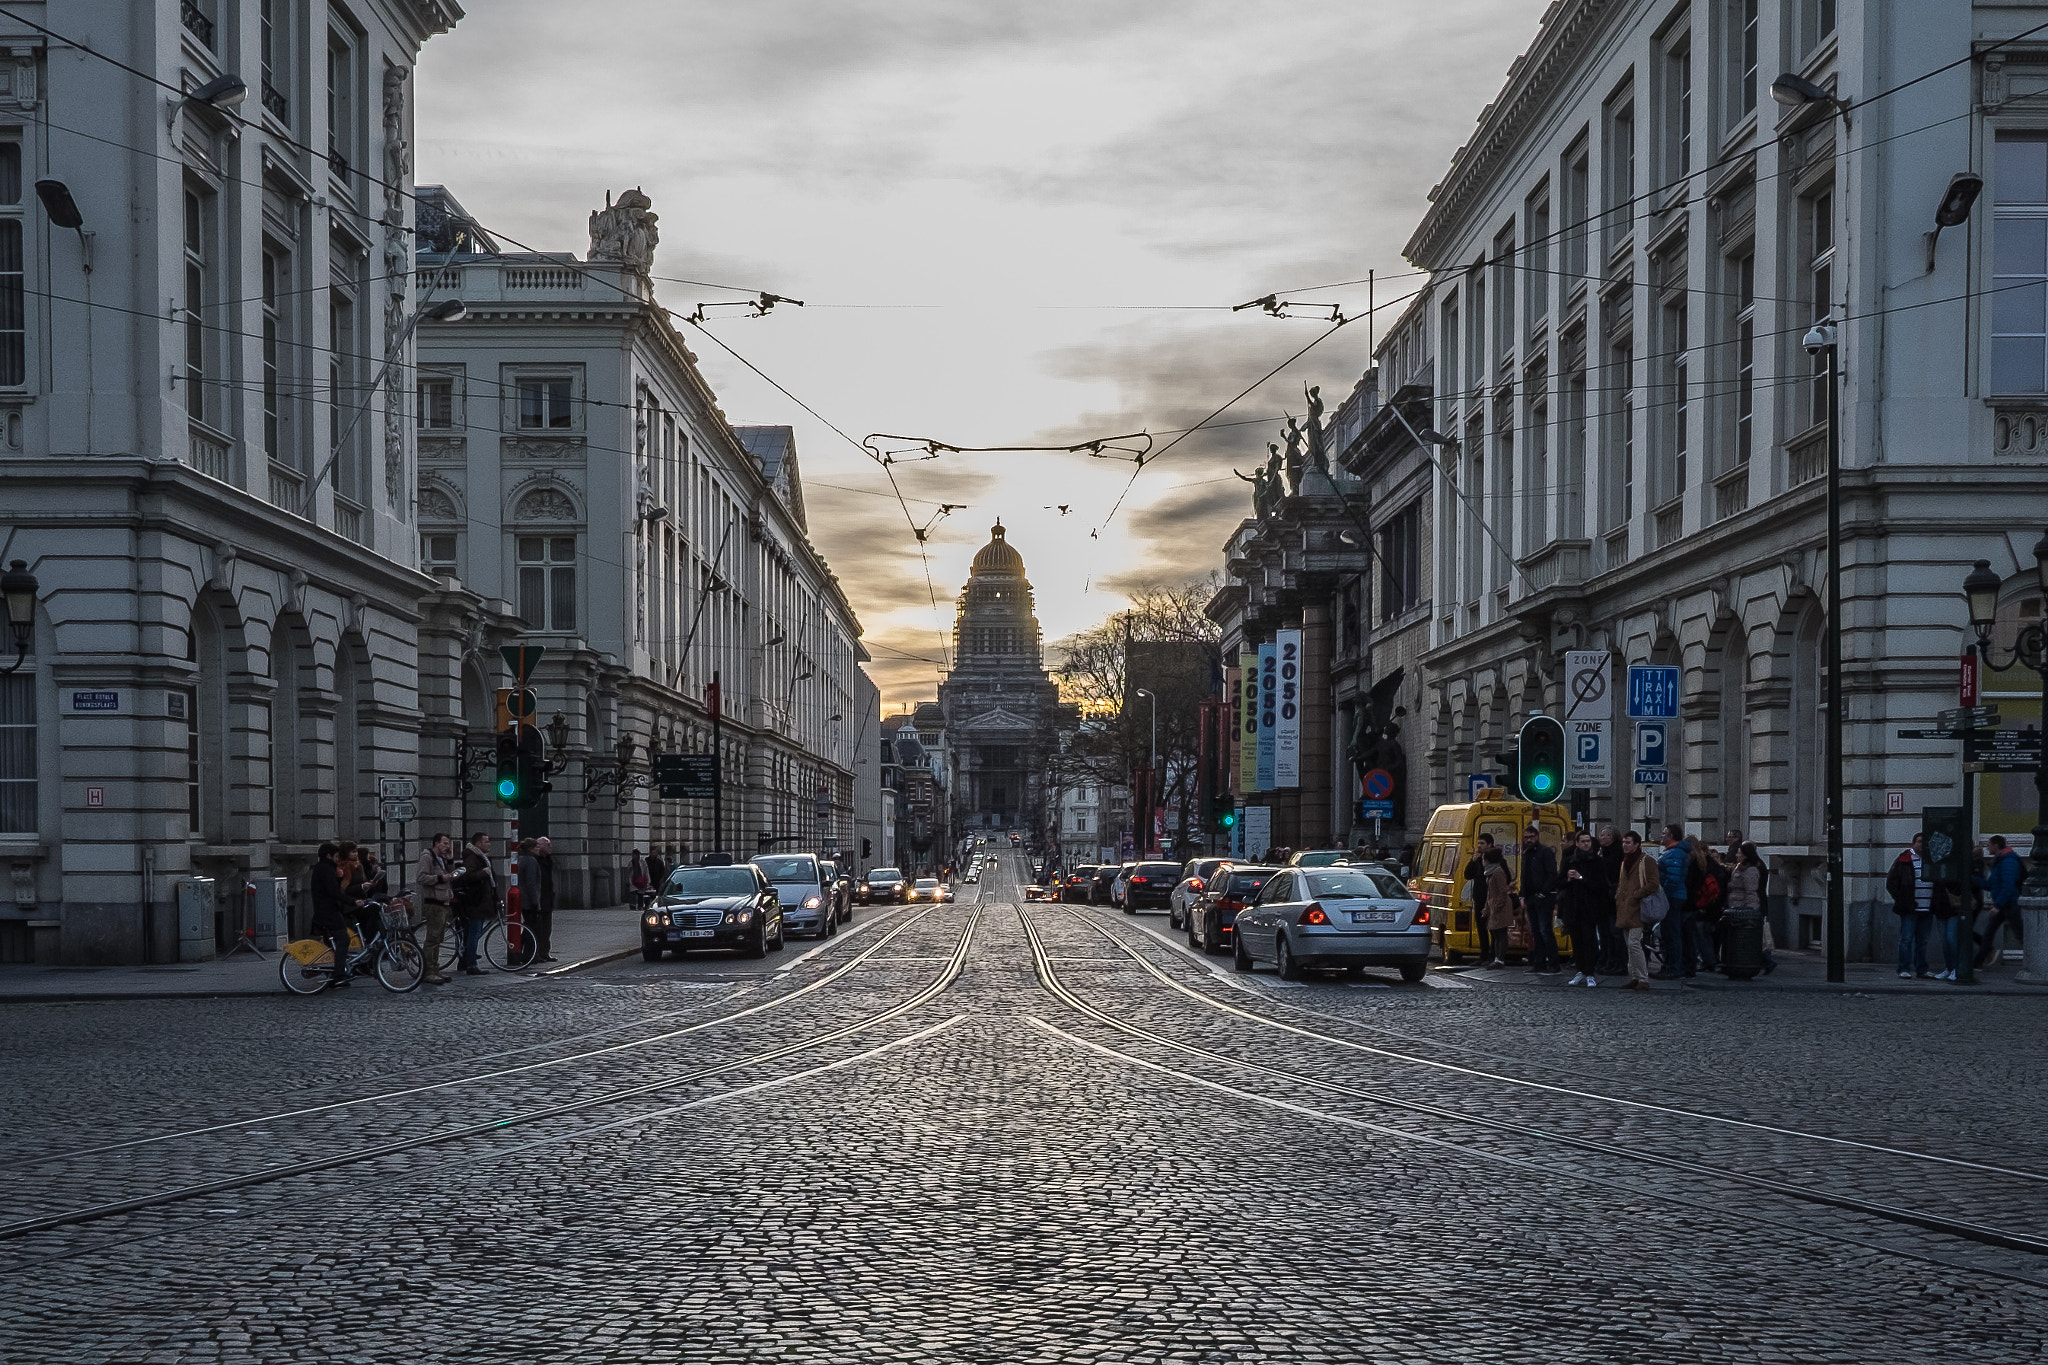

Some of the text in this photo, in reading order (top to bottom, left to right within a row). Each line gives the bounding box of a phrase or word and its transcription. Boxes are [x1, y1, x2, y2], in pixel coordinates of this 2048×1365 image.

[1574, 655, 1604, 664] ZONE
[1262, 656, 1276, 728] 2050
[1281, 643, 1297, 720] 2050
[1644, 670, 1653, 716] TRAM
[1655, 670, 1663, 716] TAXI
[1231, 680, 1242, 742] 2050
[1245, 667, 1258, 734] 2050
[1575, 722, 1602, 733] ZONE
[1581, 738, 1596, 759] P
[1640, 729, 1662, 761] P
[1639, 771, 1665, 782] TAXI
[91, 791, 100, 803] H
[1472, 780, 1488, 801] P
[1891, 795, 1900, 808] H
